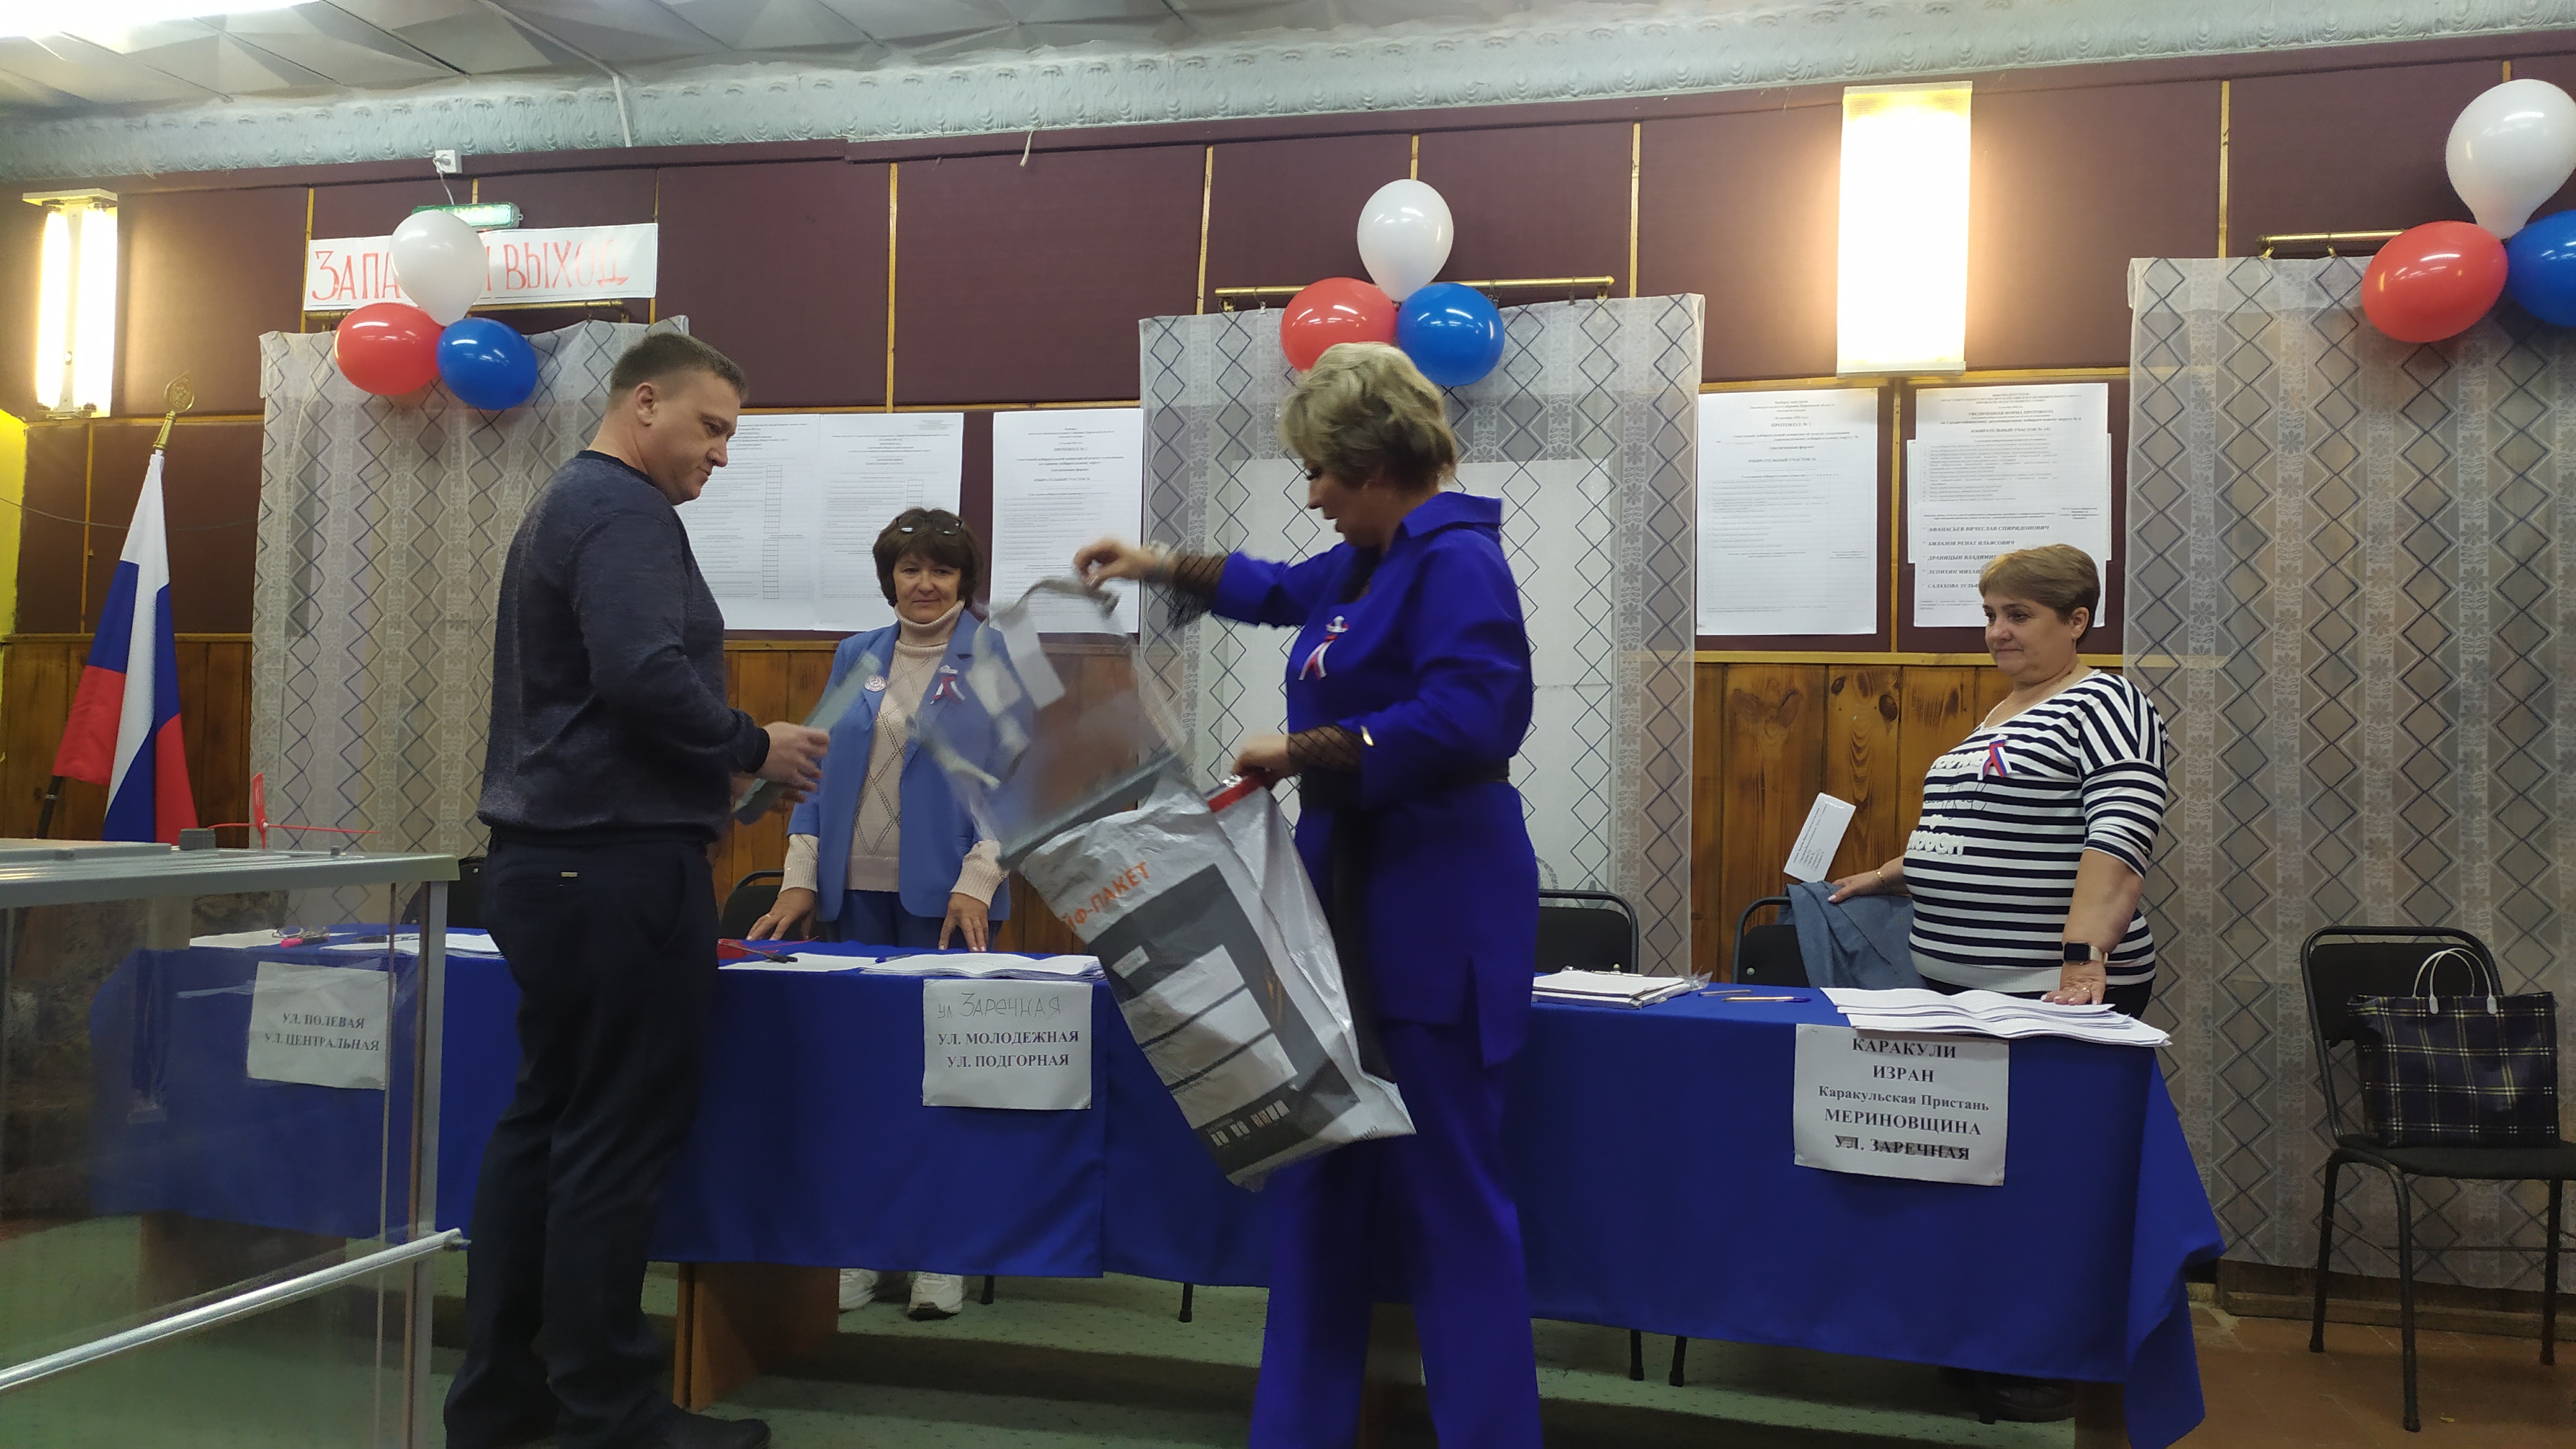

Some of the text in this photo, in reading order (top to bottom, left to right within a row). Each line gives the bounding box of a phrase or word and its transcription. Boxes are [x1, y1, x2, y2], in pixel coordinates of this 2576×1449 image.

[506, 239, 629, 290] ВЫХОД
[282, 1013, 365, 1028] УЛ. ПОЛЕВАЯ
[286, 1034, 379, 1051] ЦЕНТРАЛЬНАЯ
[938, 1030, 1079, 1046] УЛ. МОЛОДЕЖНАЯ
[1852, 1037, 1956, 1059] КАРАКУЛИ
[947, 1054, 1070, 1069] УЛ. ПОДГОРНАЯ
[1873, 1065, 1935, 1083] ИЗРАН
[1818, 1084, 1989, 1112] Каракульская Пристань
[1824, 1108, 1982, 1136] МЕРИНОВЩИНА
[1870, 1138, 1971, 1161] ЗАРЕЧНАЯ
